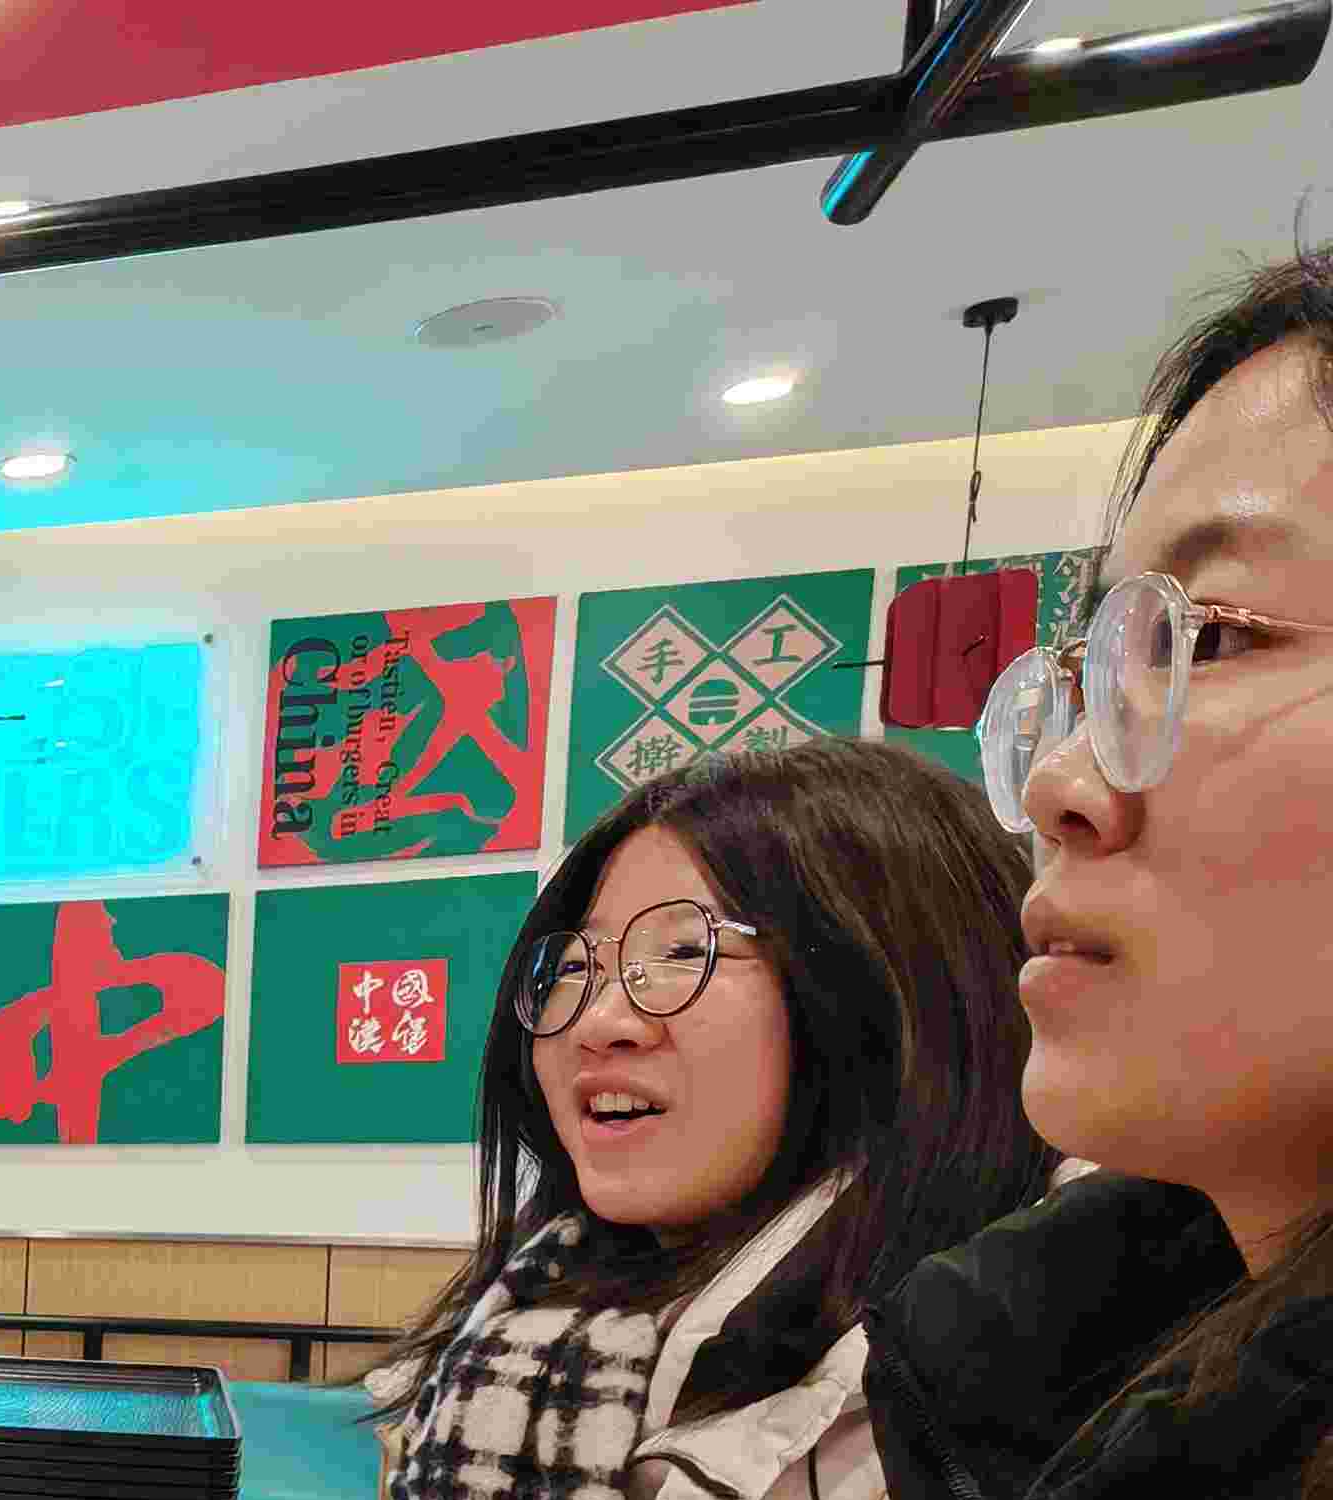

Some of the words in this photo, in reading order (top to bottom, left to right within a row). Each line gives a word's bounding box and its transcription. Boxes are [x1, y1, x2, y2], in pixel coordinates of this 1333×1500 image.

[271, 637, 341, 840] China
[340, 703, 371, 805] burgers
[338, 811, 364, 837] in
